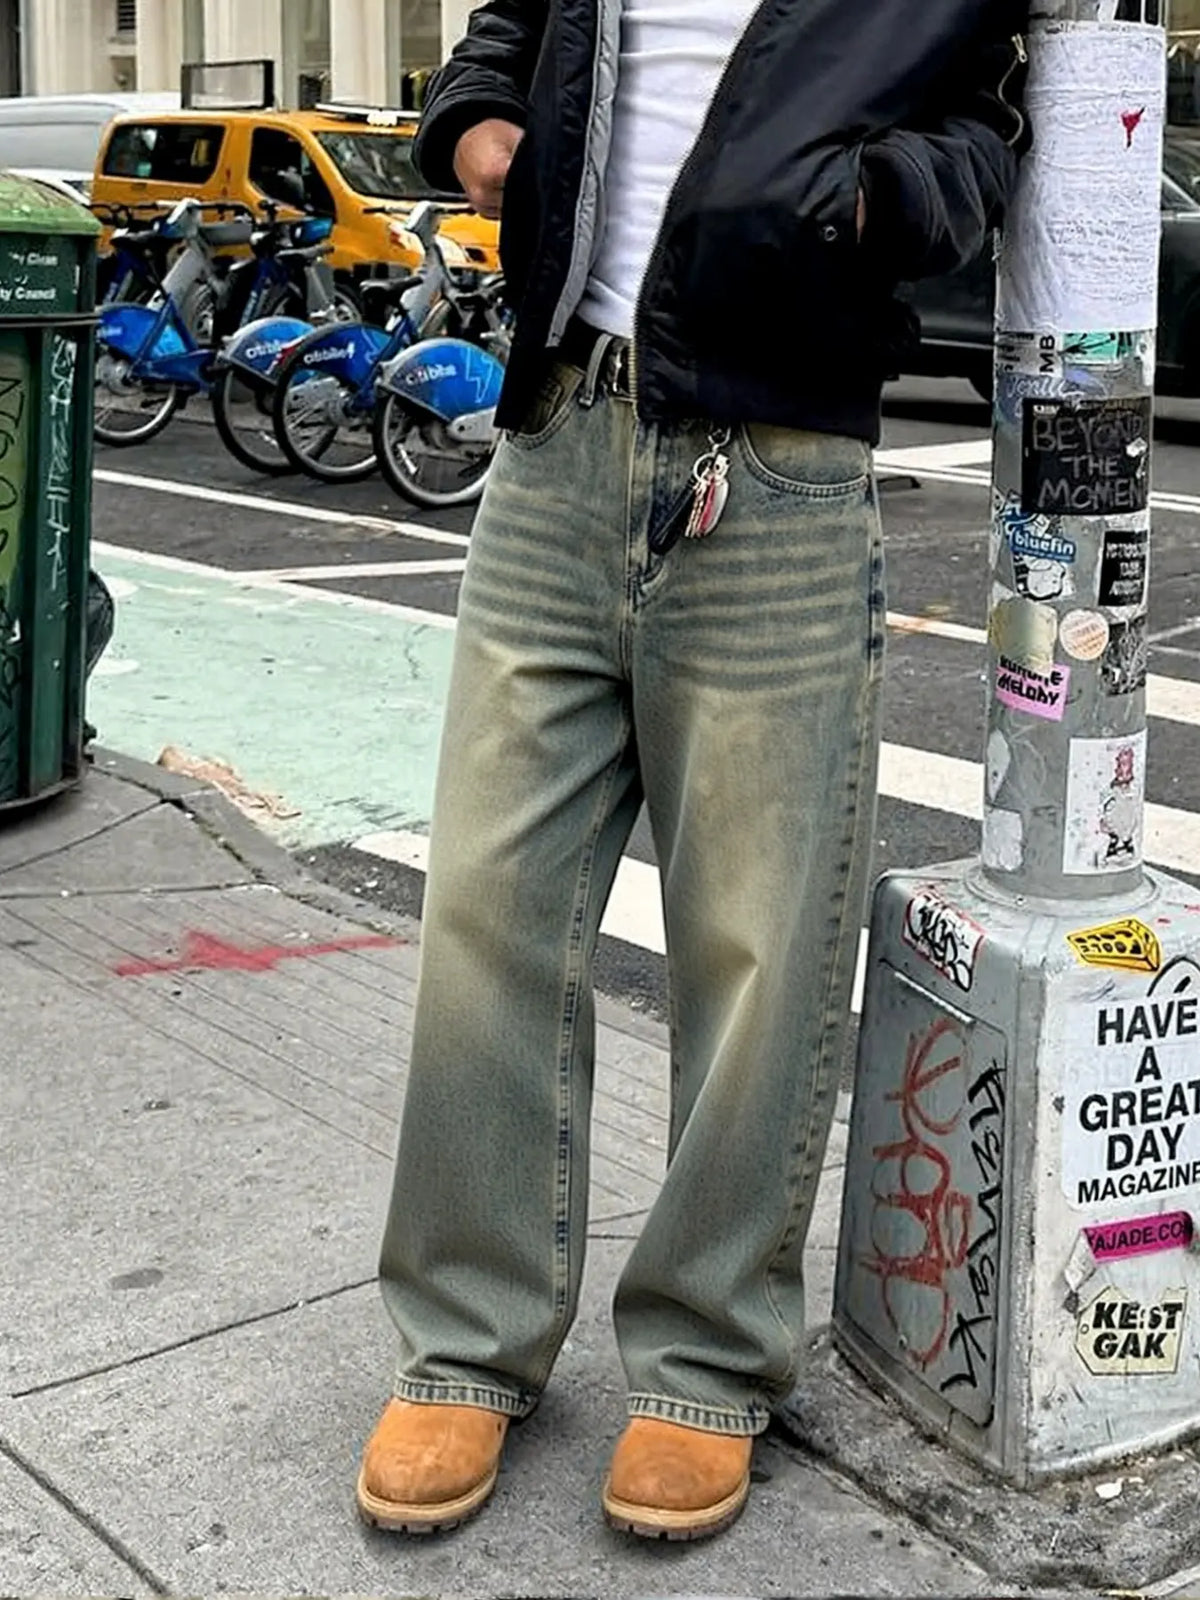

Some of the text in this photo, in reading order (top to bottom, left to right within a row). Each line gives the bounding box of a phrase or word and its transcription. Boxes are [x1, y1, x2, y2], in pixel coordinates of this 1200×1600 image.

[1060, 455, 1118, 478] THE
[1014, 529, 1074, 555] bluefin
[1097, 998, 1198, 1046] HAVE
[1134, 1045, 1162, 1083] A
[1079, 1080, 1200, 1132] GREAT
[1106, 1123, 1186, 1171] DAY
[1092, 1332, 1167, 1359] GAK
